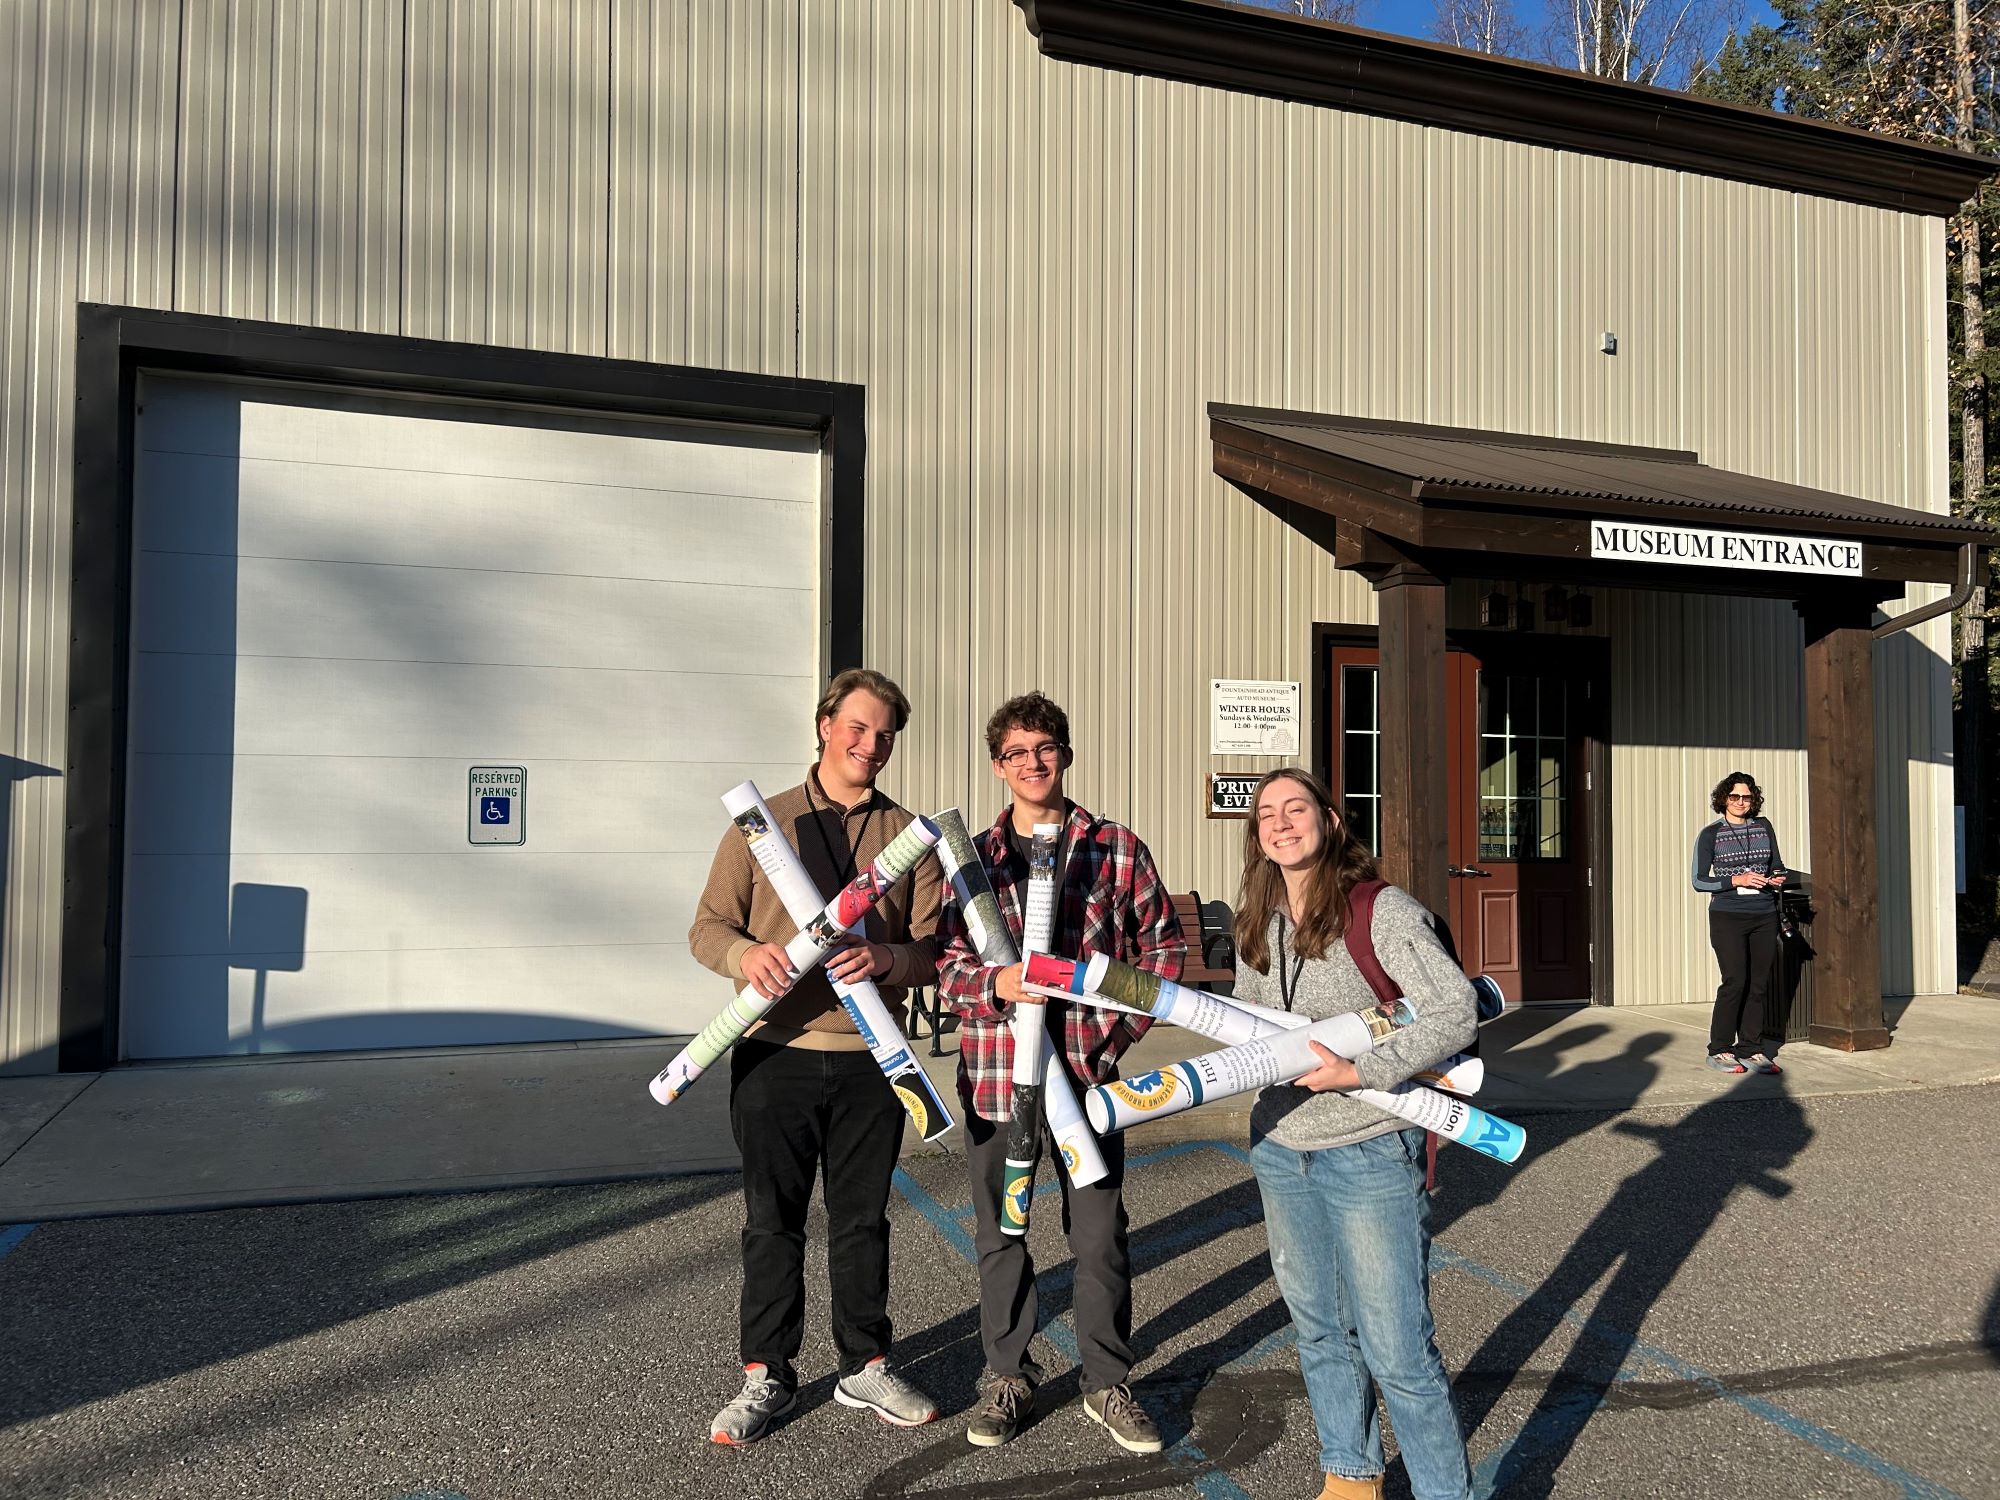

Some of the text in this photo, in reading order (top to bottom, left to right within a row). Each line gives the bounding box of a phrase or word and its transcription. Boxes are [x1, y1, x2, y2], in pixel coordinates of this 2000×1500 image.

[1594, 526, 1860, 569] MUSEUM ENTRANCE
[1218, 704, 1291, 714] WINTER HOURS
[1219, 713, 1245, 721] Sundays
[1252, 714, 1290, 722] Wednesdays
[472, 773, 521, 784] RESERVED
[475, 787, 518, 797] PARKING
[1116, 1080, 1175, 1108] TEACHING THROUGH
